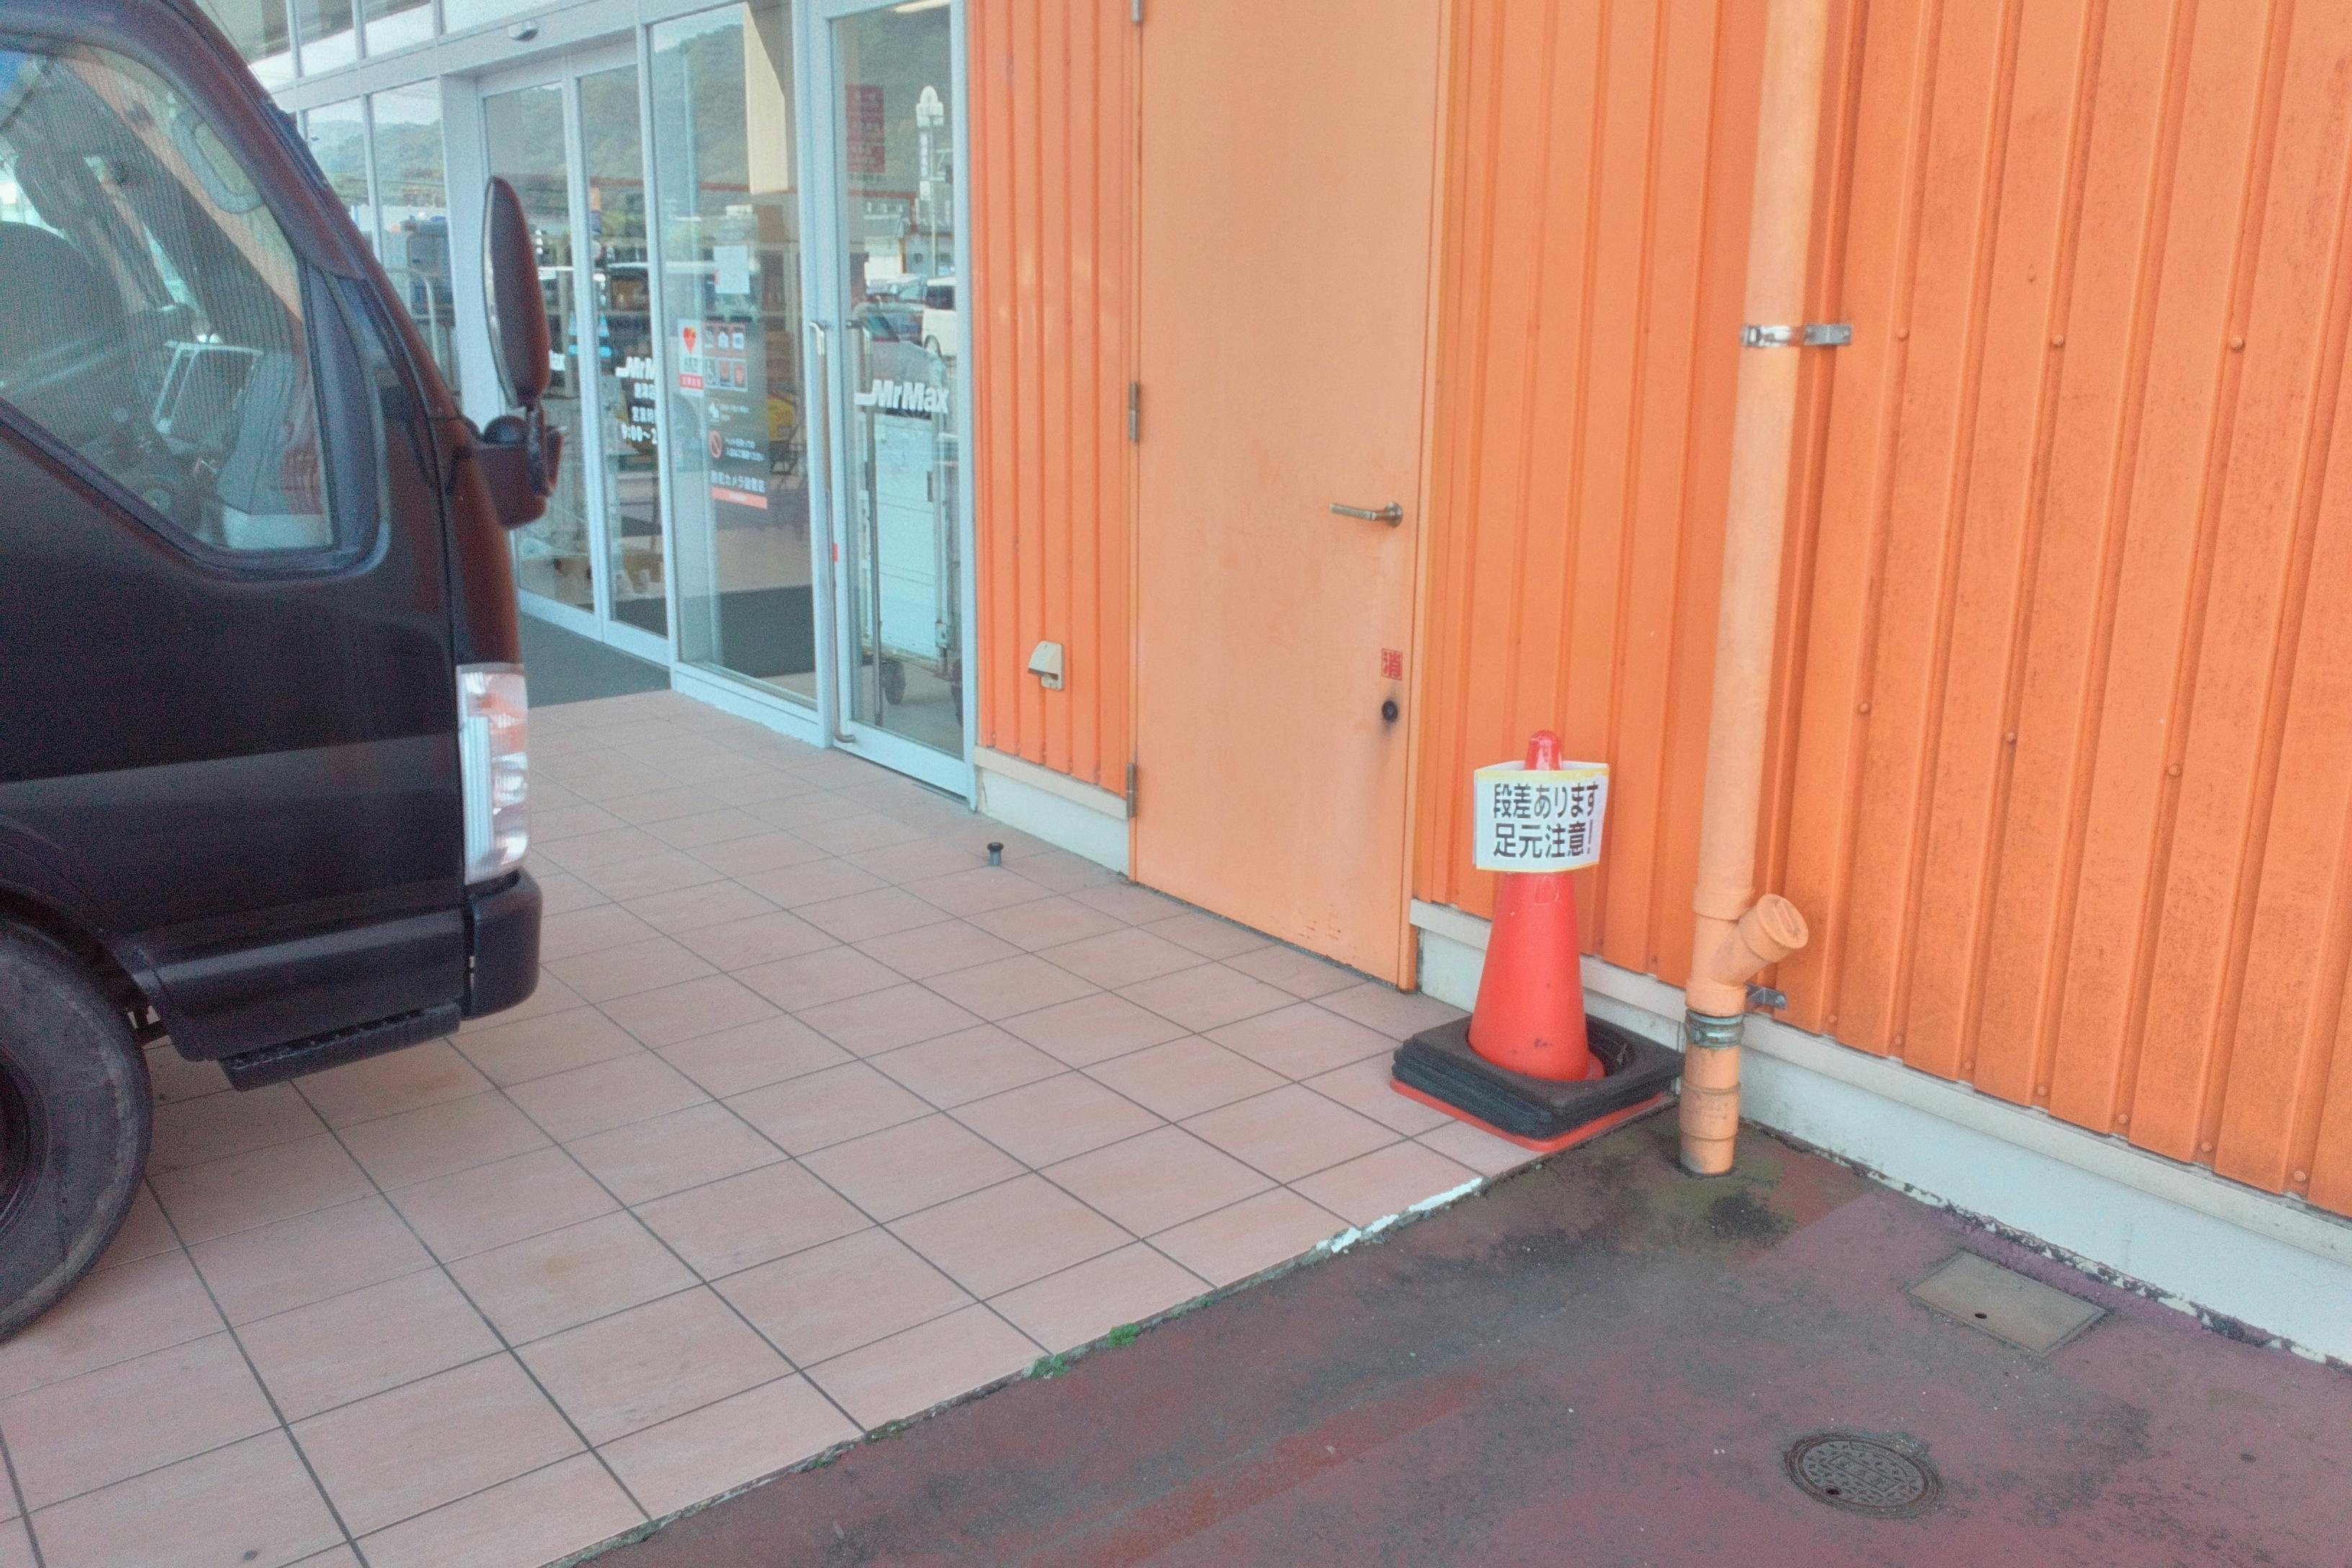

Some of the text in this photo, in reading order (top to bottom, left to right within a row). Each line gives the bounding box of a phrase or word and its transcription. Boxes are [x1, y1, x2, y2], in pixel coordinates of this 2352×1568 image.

[855, 379, 949, 414] MrMax
[1493, 781, 1599, 819] 段差あります
[1493, 819, 1593, 859] 足元注意!
